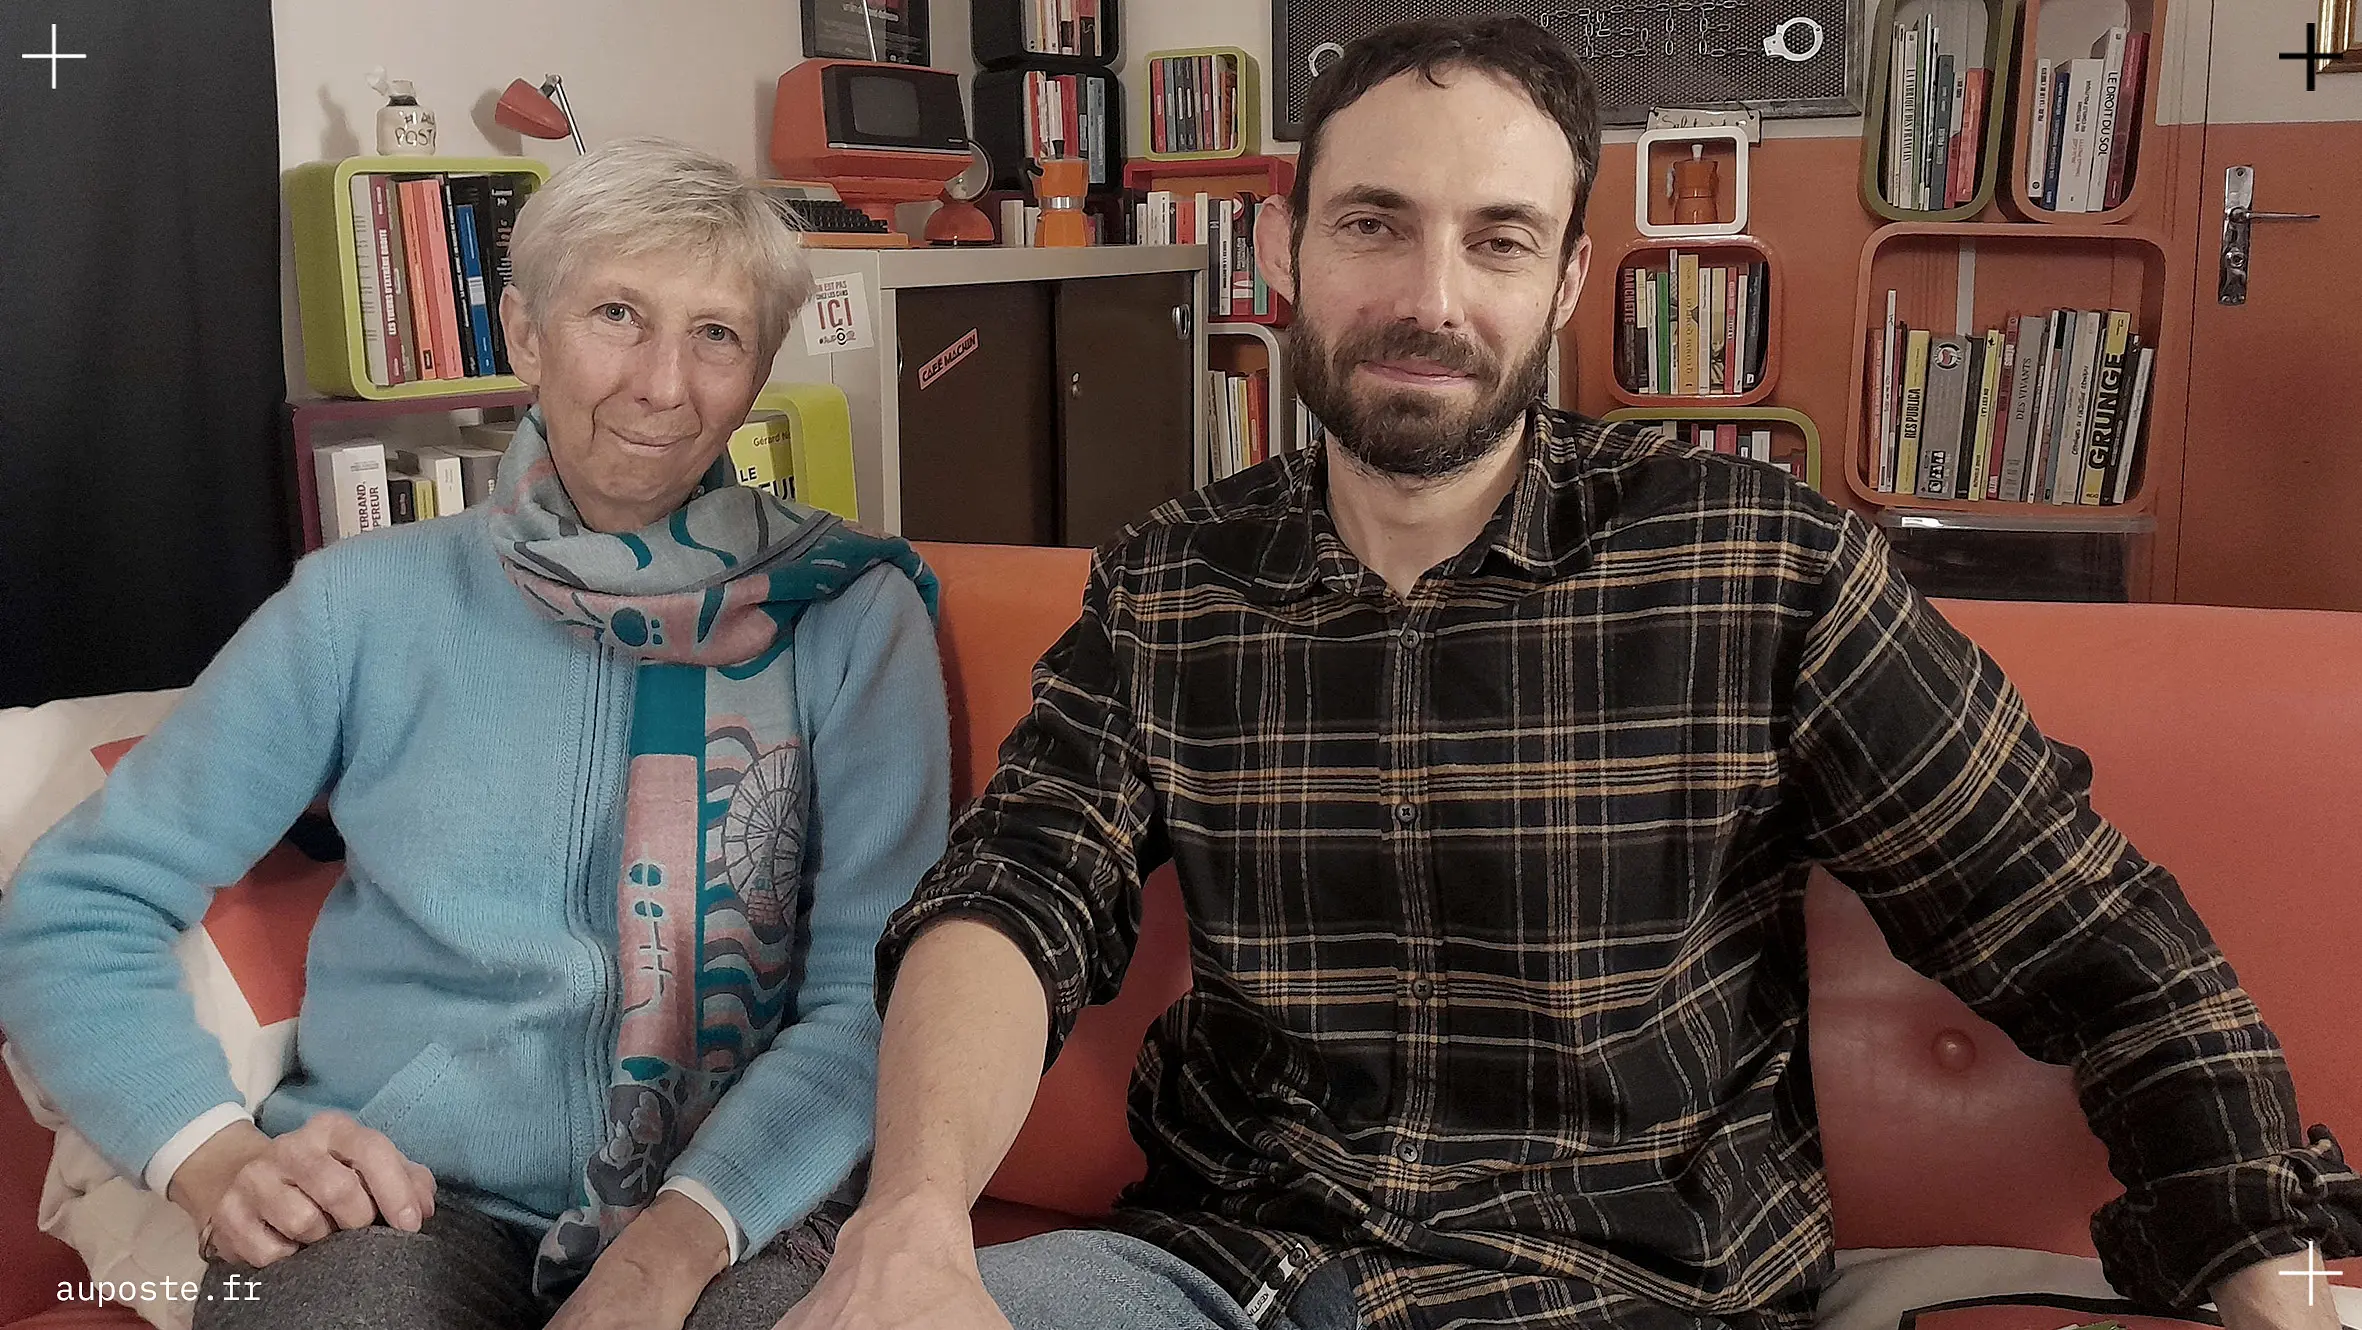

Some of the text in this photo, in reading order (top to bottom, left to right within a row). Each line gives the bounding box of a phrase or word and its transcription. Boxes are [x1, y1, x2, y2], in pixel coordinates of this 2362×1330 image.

[1903, 69, 1915, 161] LA FABRIQUE DES FRANÇAIS
[2098, 72, 2117, 156] LE DROIT DU SOL
[379, 229, 389, 255] DROITE
[817, 297, 853, 330] ICI
[1624, 268, 1635, 323] MANCHETTE
[388, 321, 397, 335] LES
[922, 334, 976, 382] CAFÉ MACHIN
[1906, 388, 1921, 422] PUBLICA
[2016, 358, 2031, 420] DES VIVANTS
[2088, 353, 2124, 469] GRUNGE
[753, 433, 780, 447] Gérard
[1904, 424, 1918, 439] RES
[740, 466, 757, 482] LE
[370, 486, 381, 528] PEREUR
